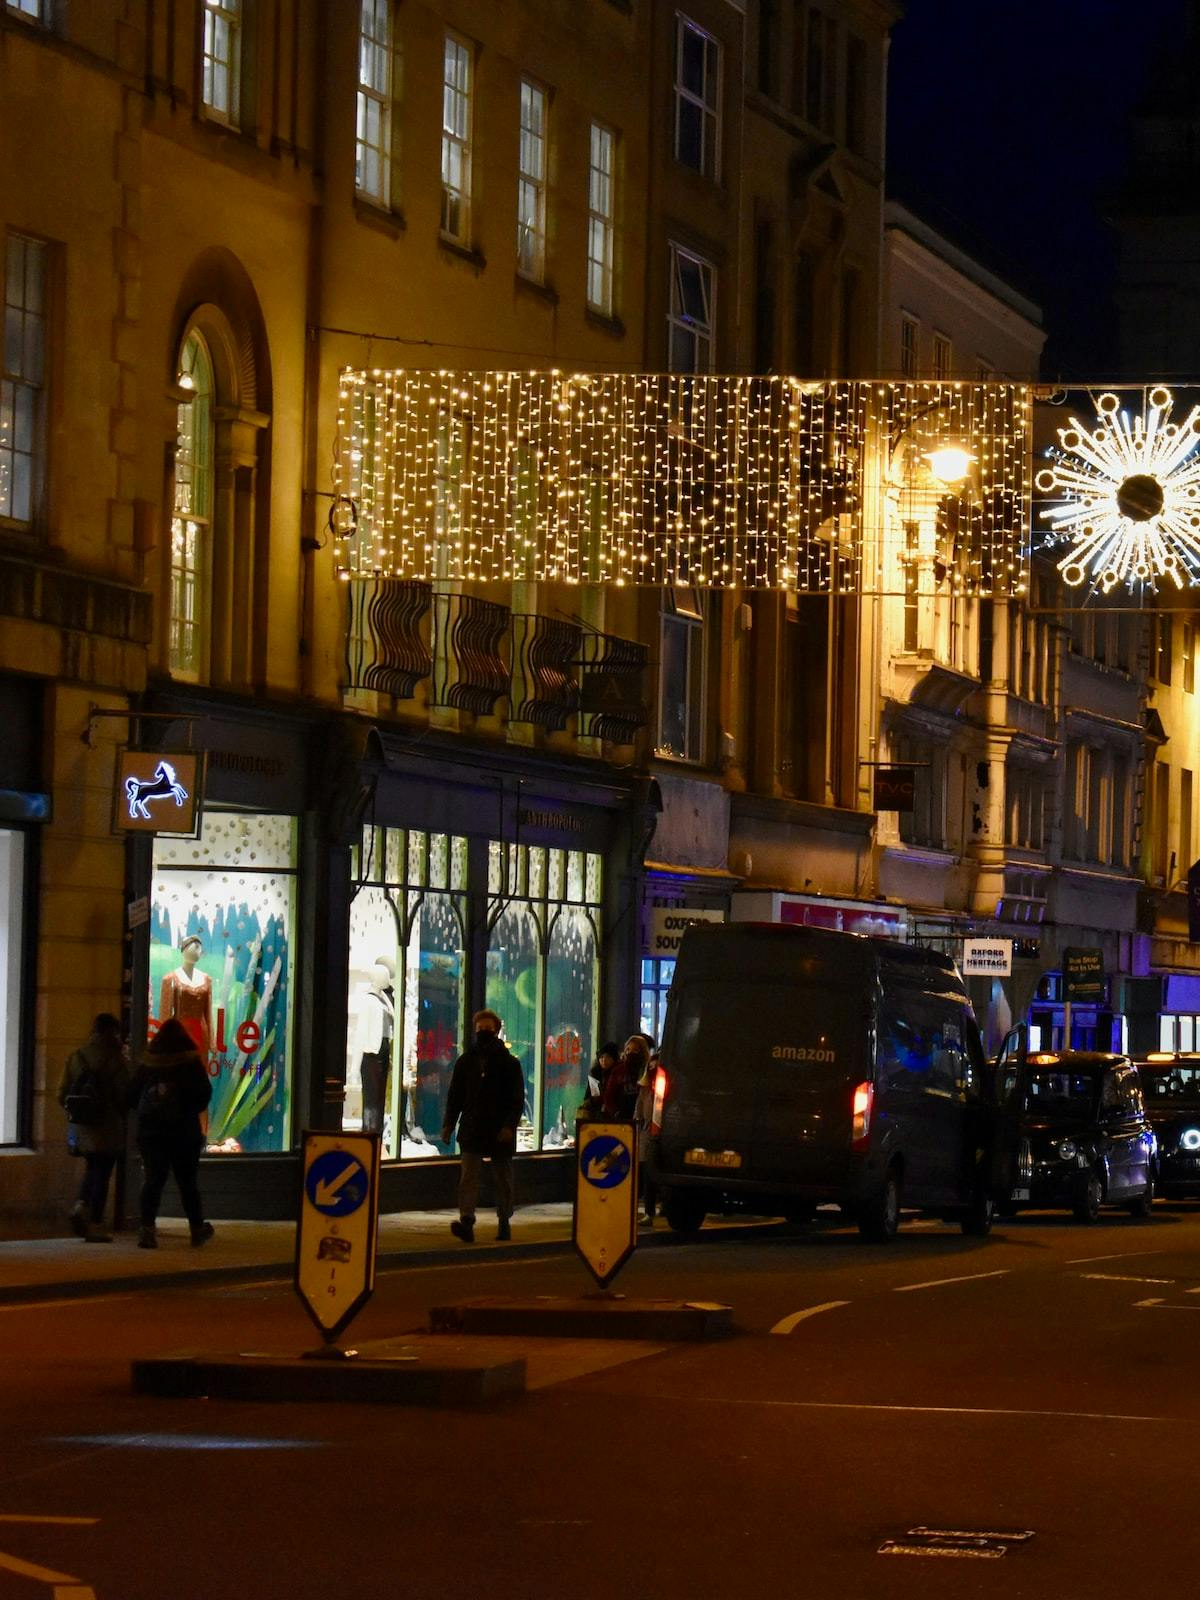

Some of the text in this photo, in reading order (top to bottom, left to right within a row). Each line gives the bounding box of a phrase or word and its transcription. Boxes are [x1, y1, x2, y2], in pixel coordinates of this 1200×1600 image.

[971, 949, 1004, 957] OXFORD
[966, 959, 1008, 968] HERITAGE
[416, 1022, 454, 1061] sale
[546, 1027, 582, 1065] sale
[771, 1045, 836, 1064] amazon
